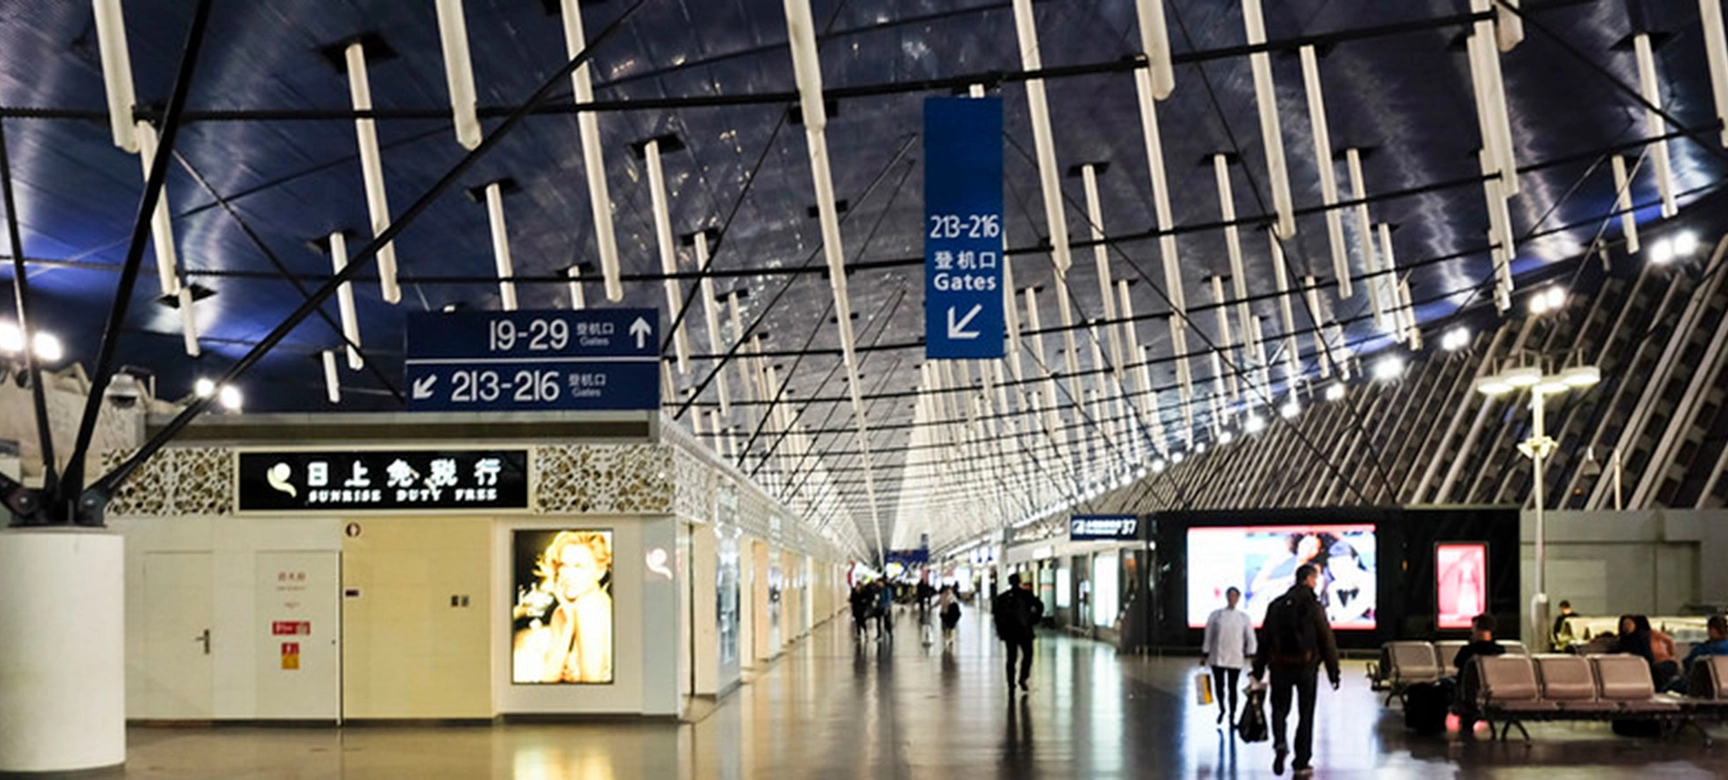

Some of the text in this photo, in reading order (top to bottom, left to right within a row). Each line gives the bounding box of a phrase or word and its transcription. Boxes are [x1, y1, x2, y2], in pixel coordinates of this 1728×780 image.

[929, 214, 1000, 239] 213-216
[934, 250, 997, 270] 登机口
[933, 272, 997, 292] Gates
[489, 318, 570, 351] 19-29
[576, 322, 615, 336] 登机口
[579, 336, 610, 347] Gates
[451, 369, 561, 402] 213-216
[568, 373, 607, 387] 登机口
[571, 387, 601, 398] Gates
[307, 457, 501, 488] 日上免税行
[308, 487, 498, 503] SUNRISE DUTY FREE
